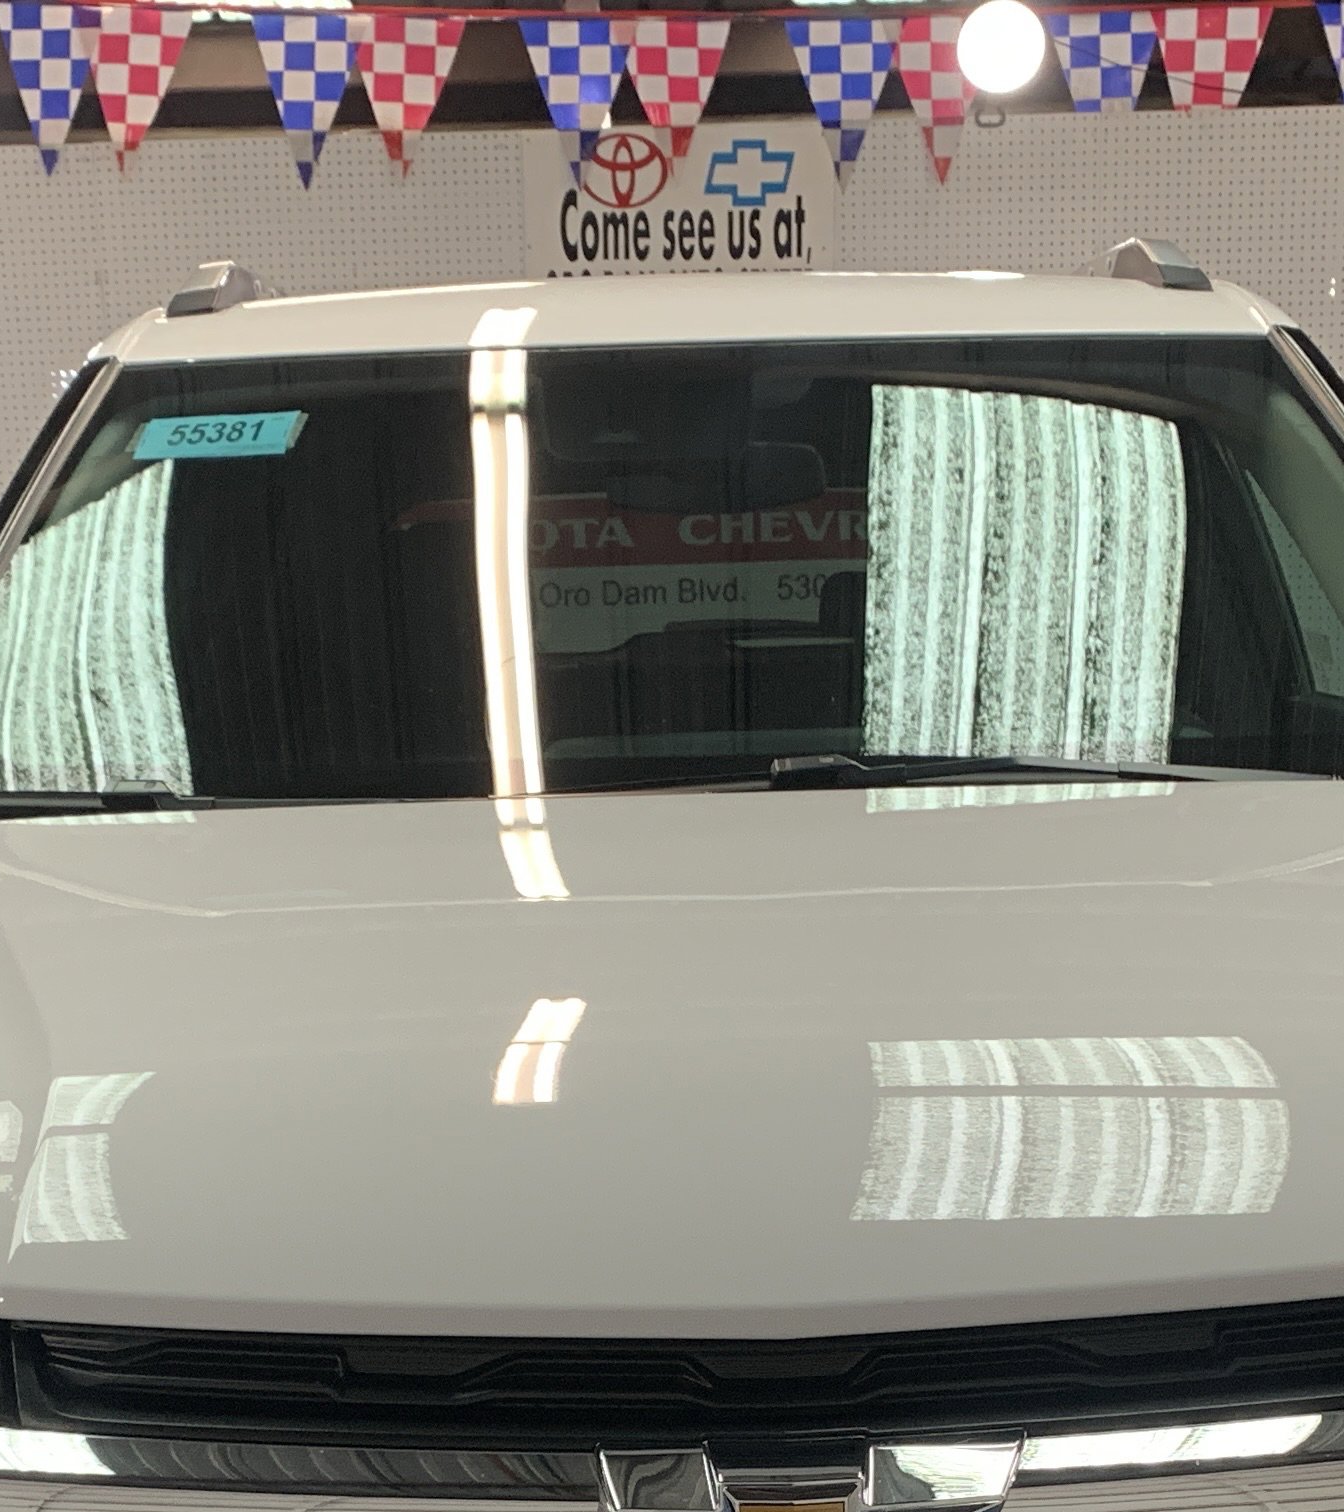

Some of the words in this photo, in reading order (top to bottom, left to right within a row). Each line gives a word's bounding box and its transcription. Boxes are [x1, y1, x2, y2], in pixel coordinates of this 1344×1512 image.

[560, 188, 651, 262] Come
[662, 208, 716, 261] see
[727, 207, 762, 261] us
[166, 419, 266, 446] 55381
[528, 515, 635, 553] OTA
[677, 509, 868, 546] CHEVR
[539, 581, 591, 608] Oro
[602, 578, 668, 606] Dam
[678, 576, 748, 604] Blvd.
